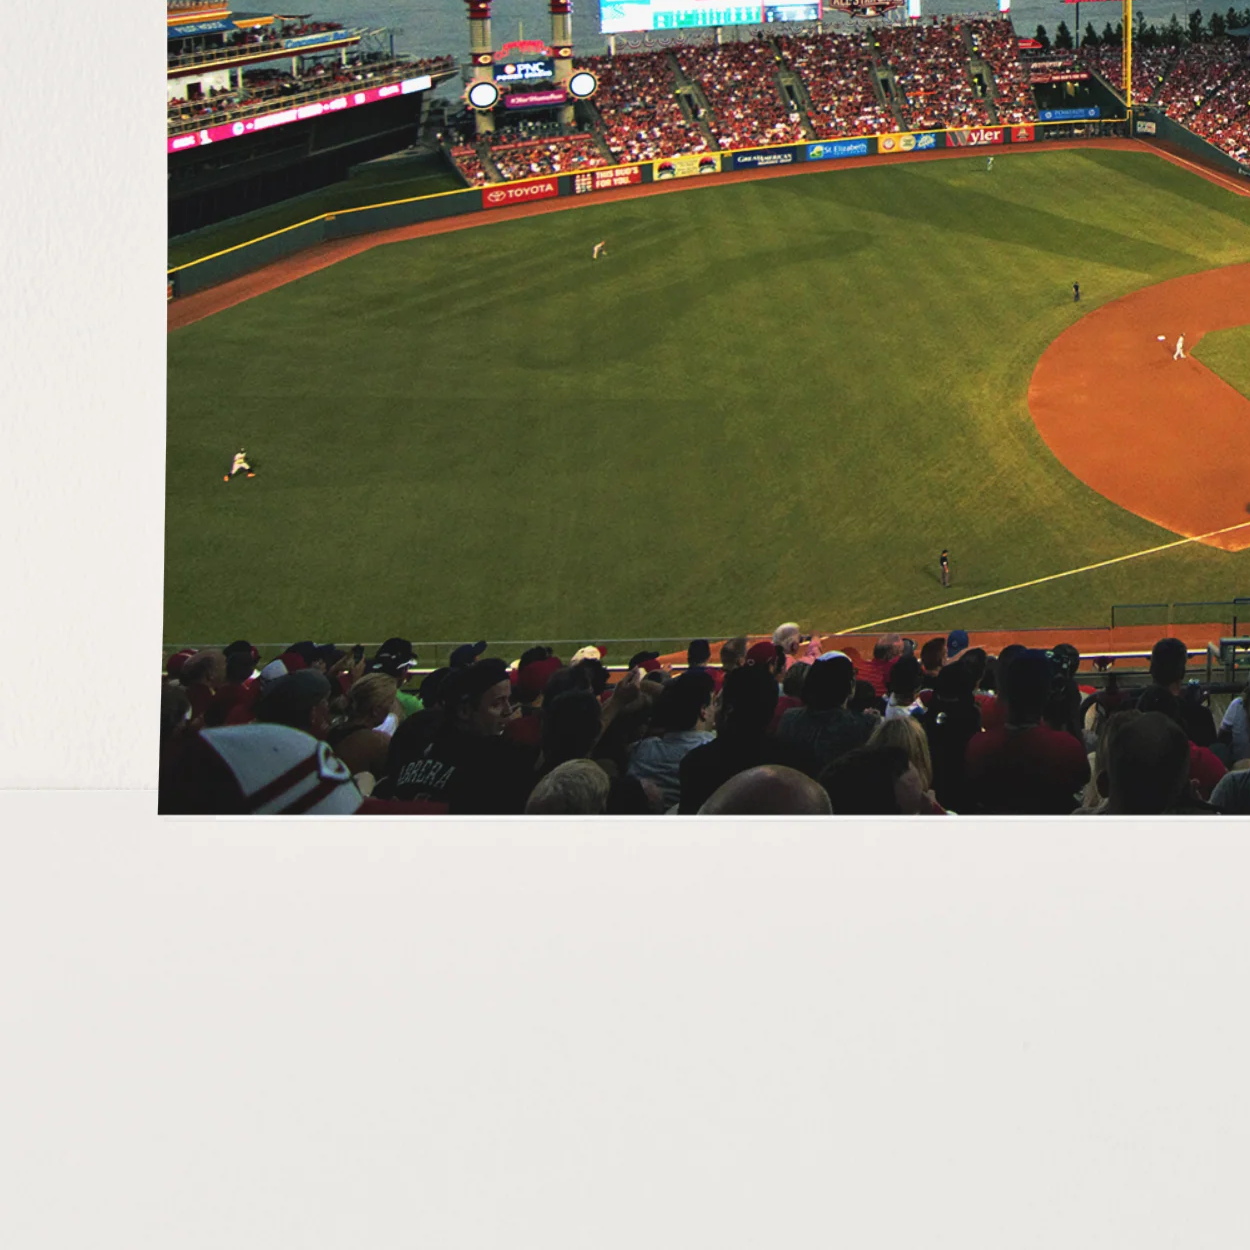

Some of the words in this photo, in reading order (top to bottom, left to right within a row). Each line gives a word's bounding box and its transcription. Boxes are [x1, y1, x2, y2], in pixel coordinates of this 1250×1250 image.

[516, 62, 545, 75] PNC
[947, 129, 1001, 146] Wyler
[596, 170, 613, 180] THIS
[596, 178, 612, 188] FOR
[508, 183, 554, 198] TOYOTA
